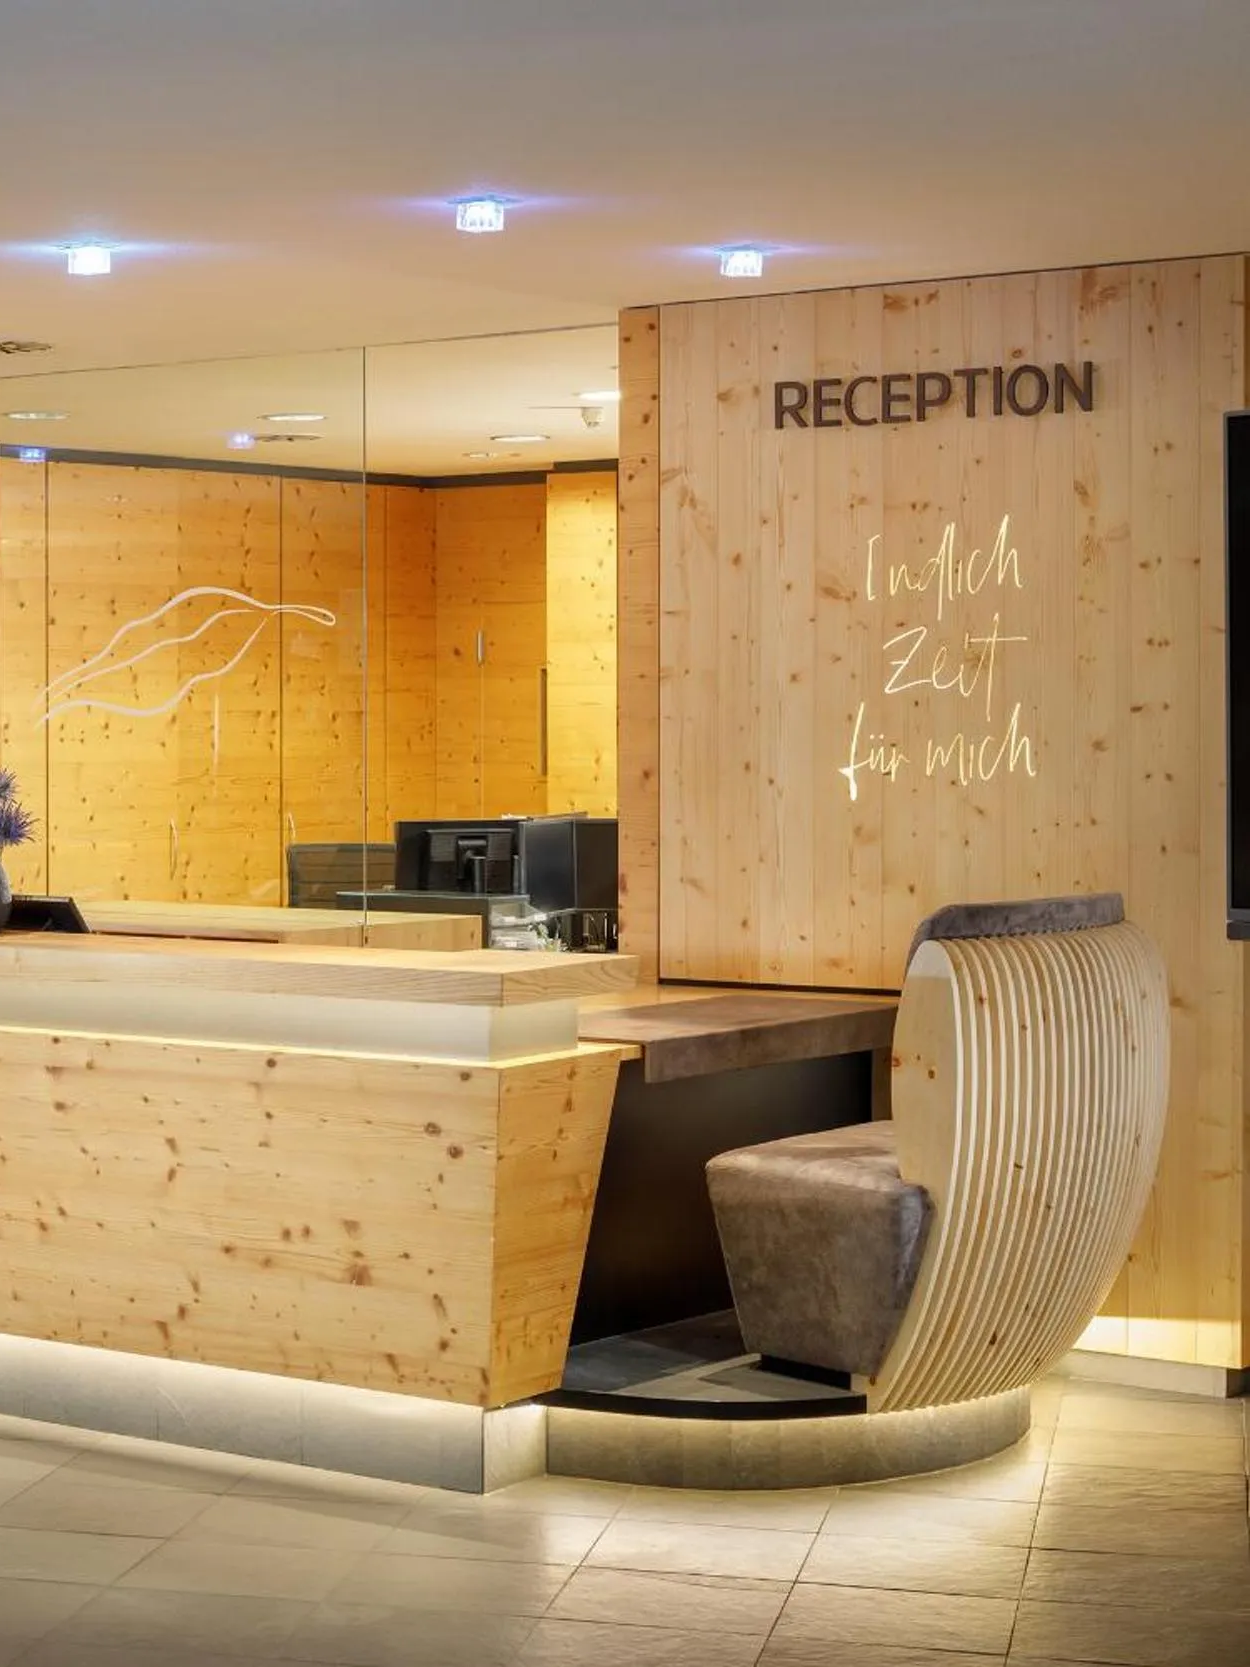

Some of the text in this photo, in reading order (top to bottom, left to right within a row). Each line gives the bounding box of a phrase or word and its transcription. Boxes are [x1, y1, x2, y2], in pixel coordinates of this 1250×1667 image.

[774, 361, 1094, 430] RECEPTION
[882, 612, 1028, 722] Zeit
[838, 702, 1036, 801] für mich
